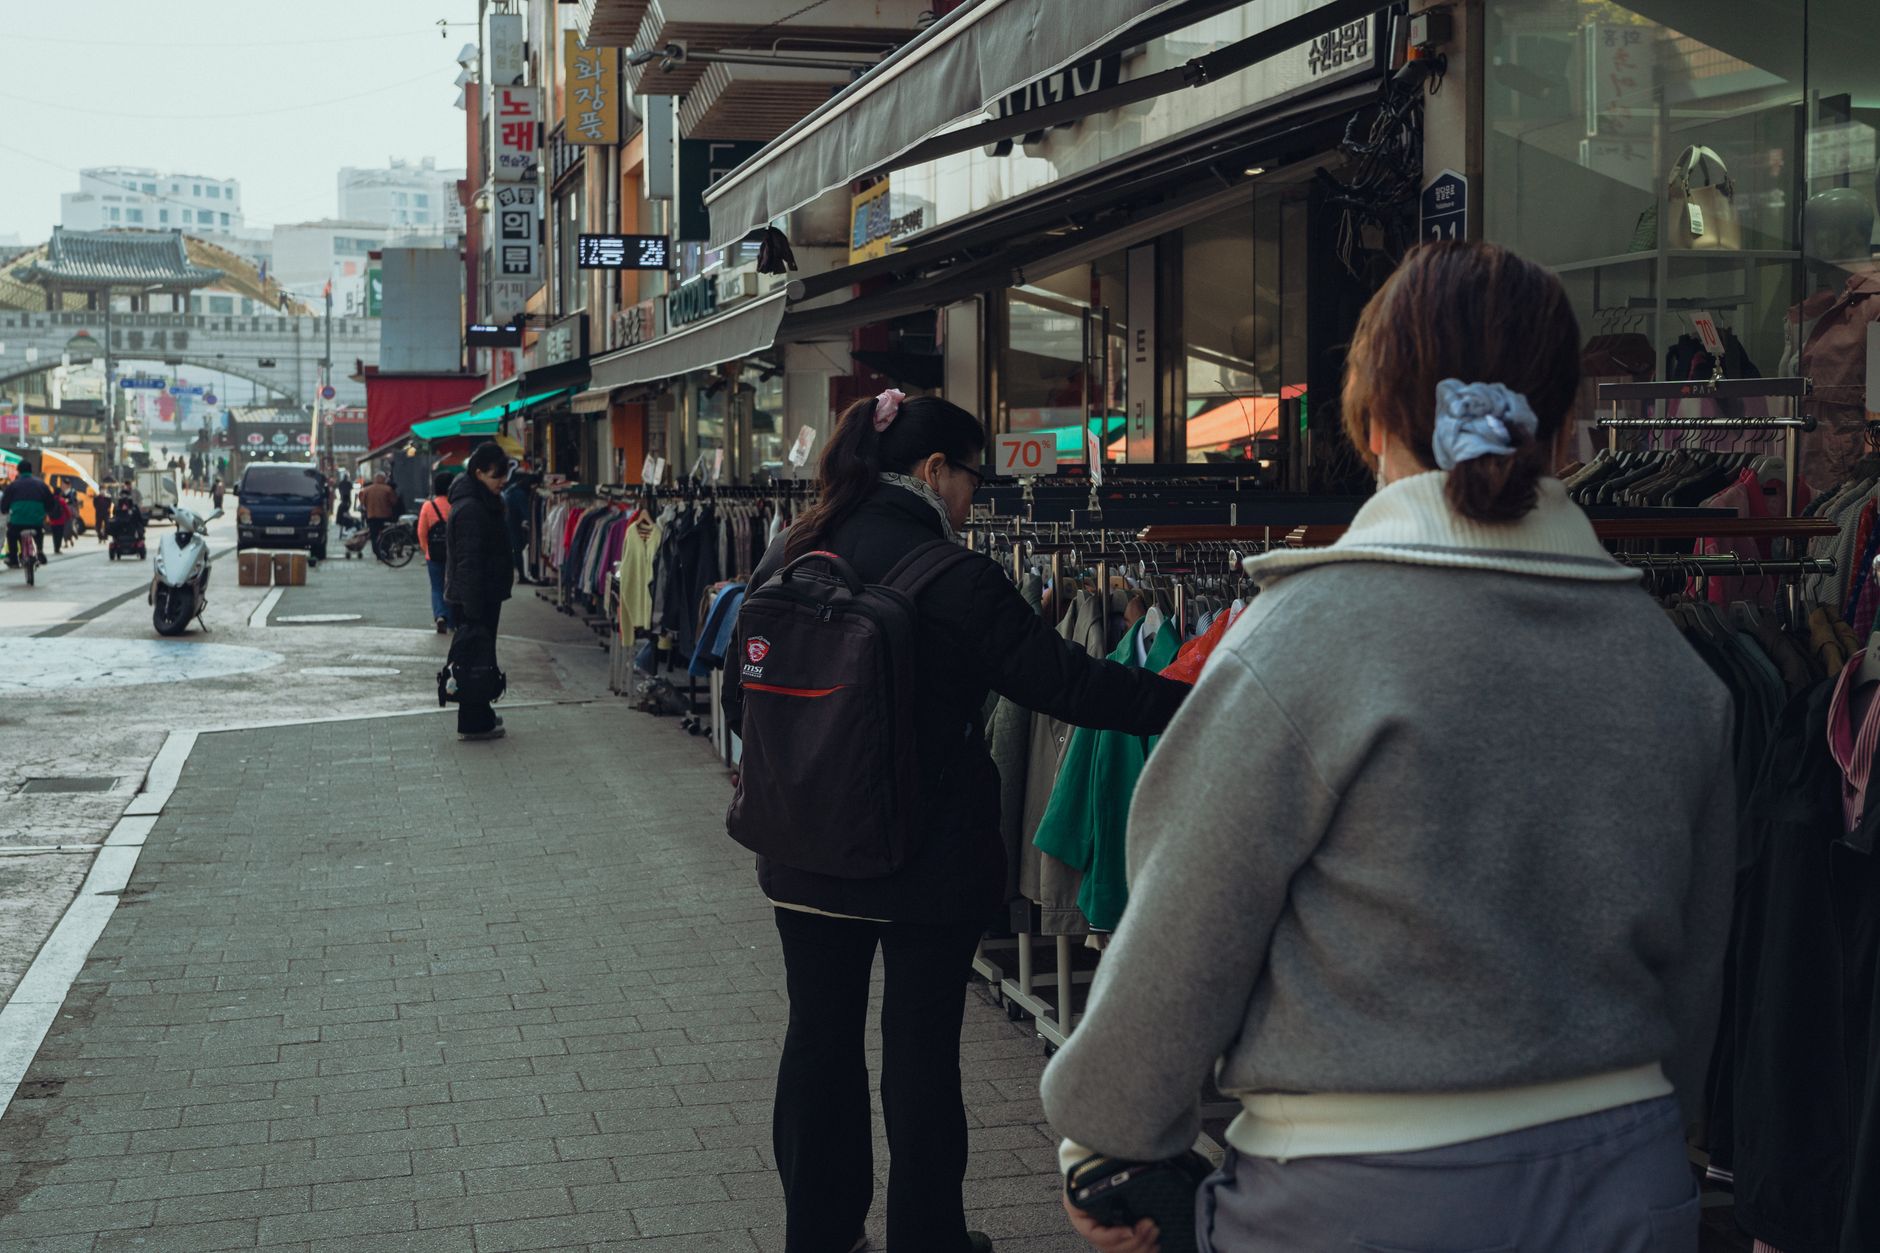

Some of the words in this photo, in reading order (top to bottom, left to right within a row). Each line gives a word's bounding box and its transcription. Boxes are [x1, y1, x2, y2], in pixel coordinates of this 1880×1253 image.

[500, 90, 535, 152] 노래
[502, 211, 531, 274] 의류
[743, 664, 764, 673] msi
